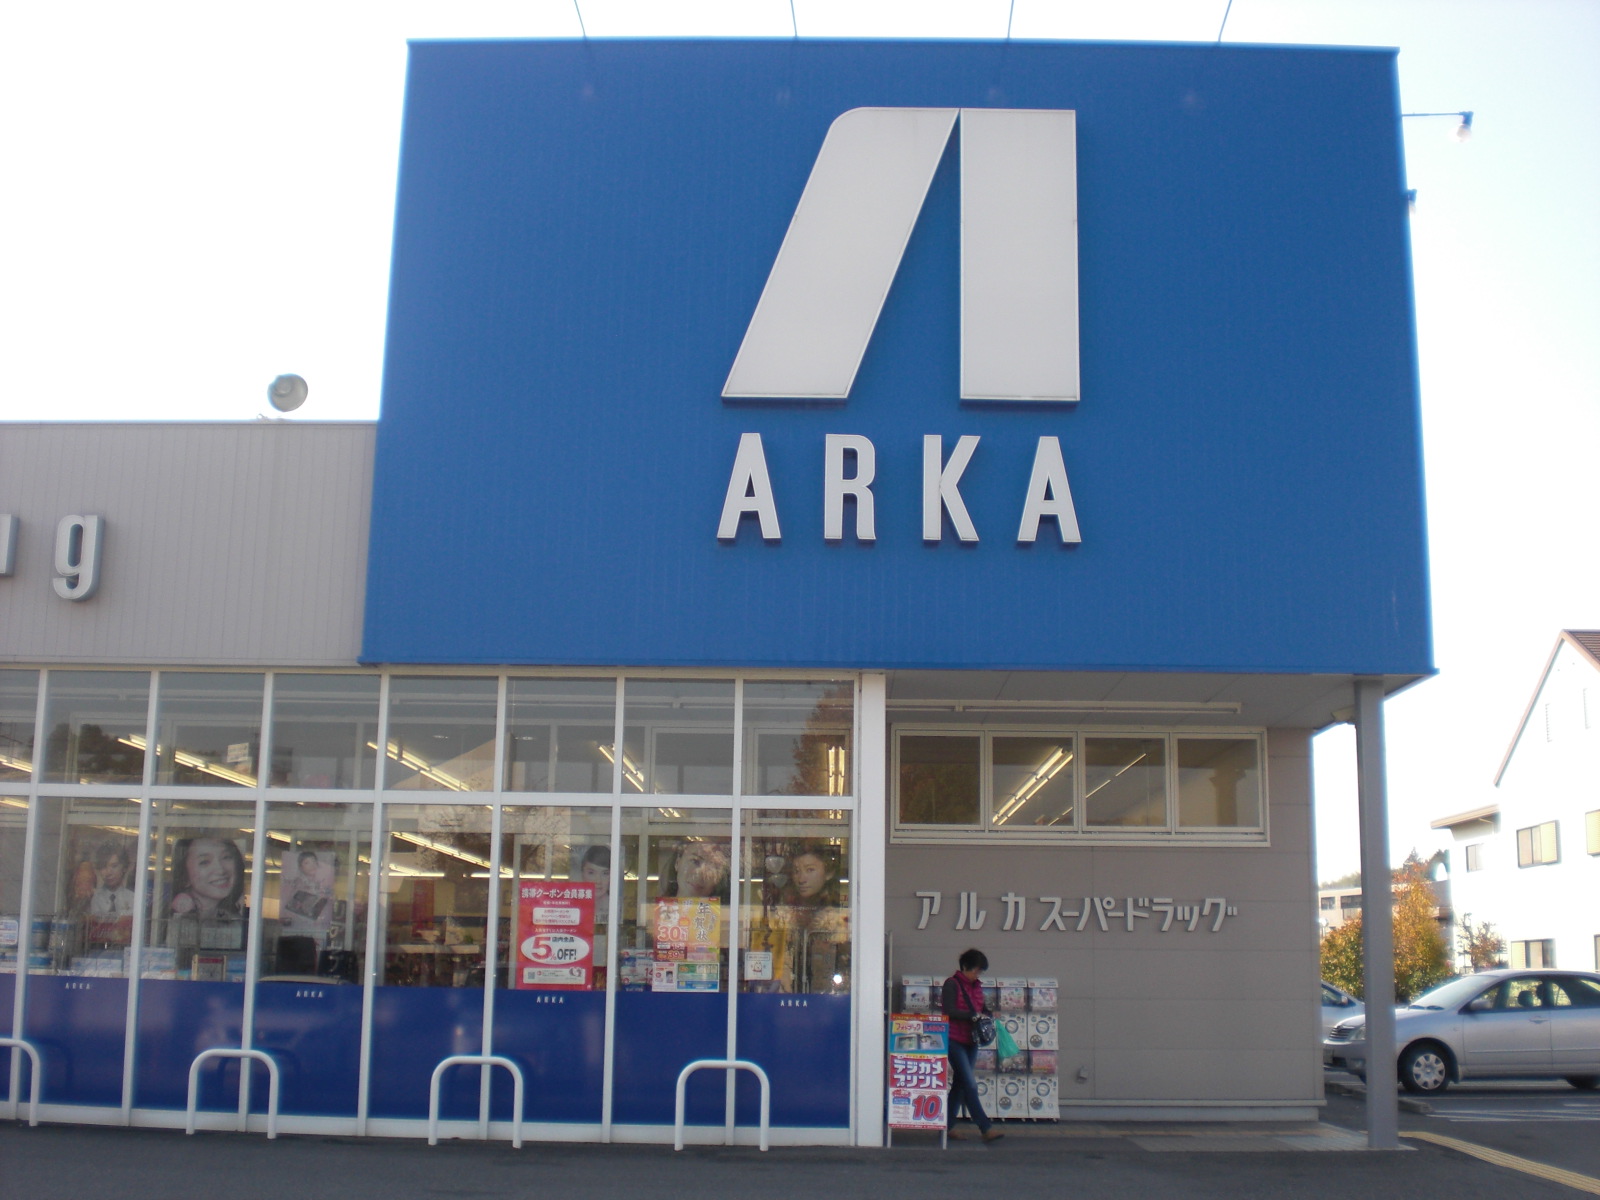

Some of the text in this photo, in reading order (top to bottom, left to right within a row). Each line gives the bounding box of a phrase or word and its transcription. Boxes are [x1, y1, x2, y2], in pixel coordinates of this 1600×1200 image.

[717, 432, 1081, 543] ARKA
[295, 990, 324, 998] ARKA
[536, 995, 564, 1004] ARKA
[780, 999, 808, 1007] ARKA
[894, 1059, 944, 1074] デジカメ
[893, 1075, 944, 1089] プリント
